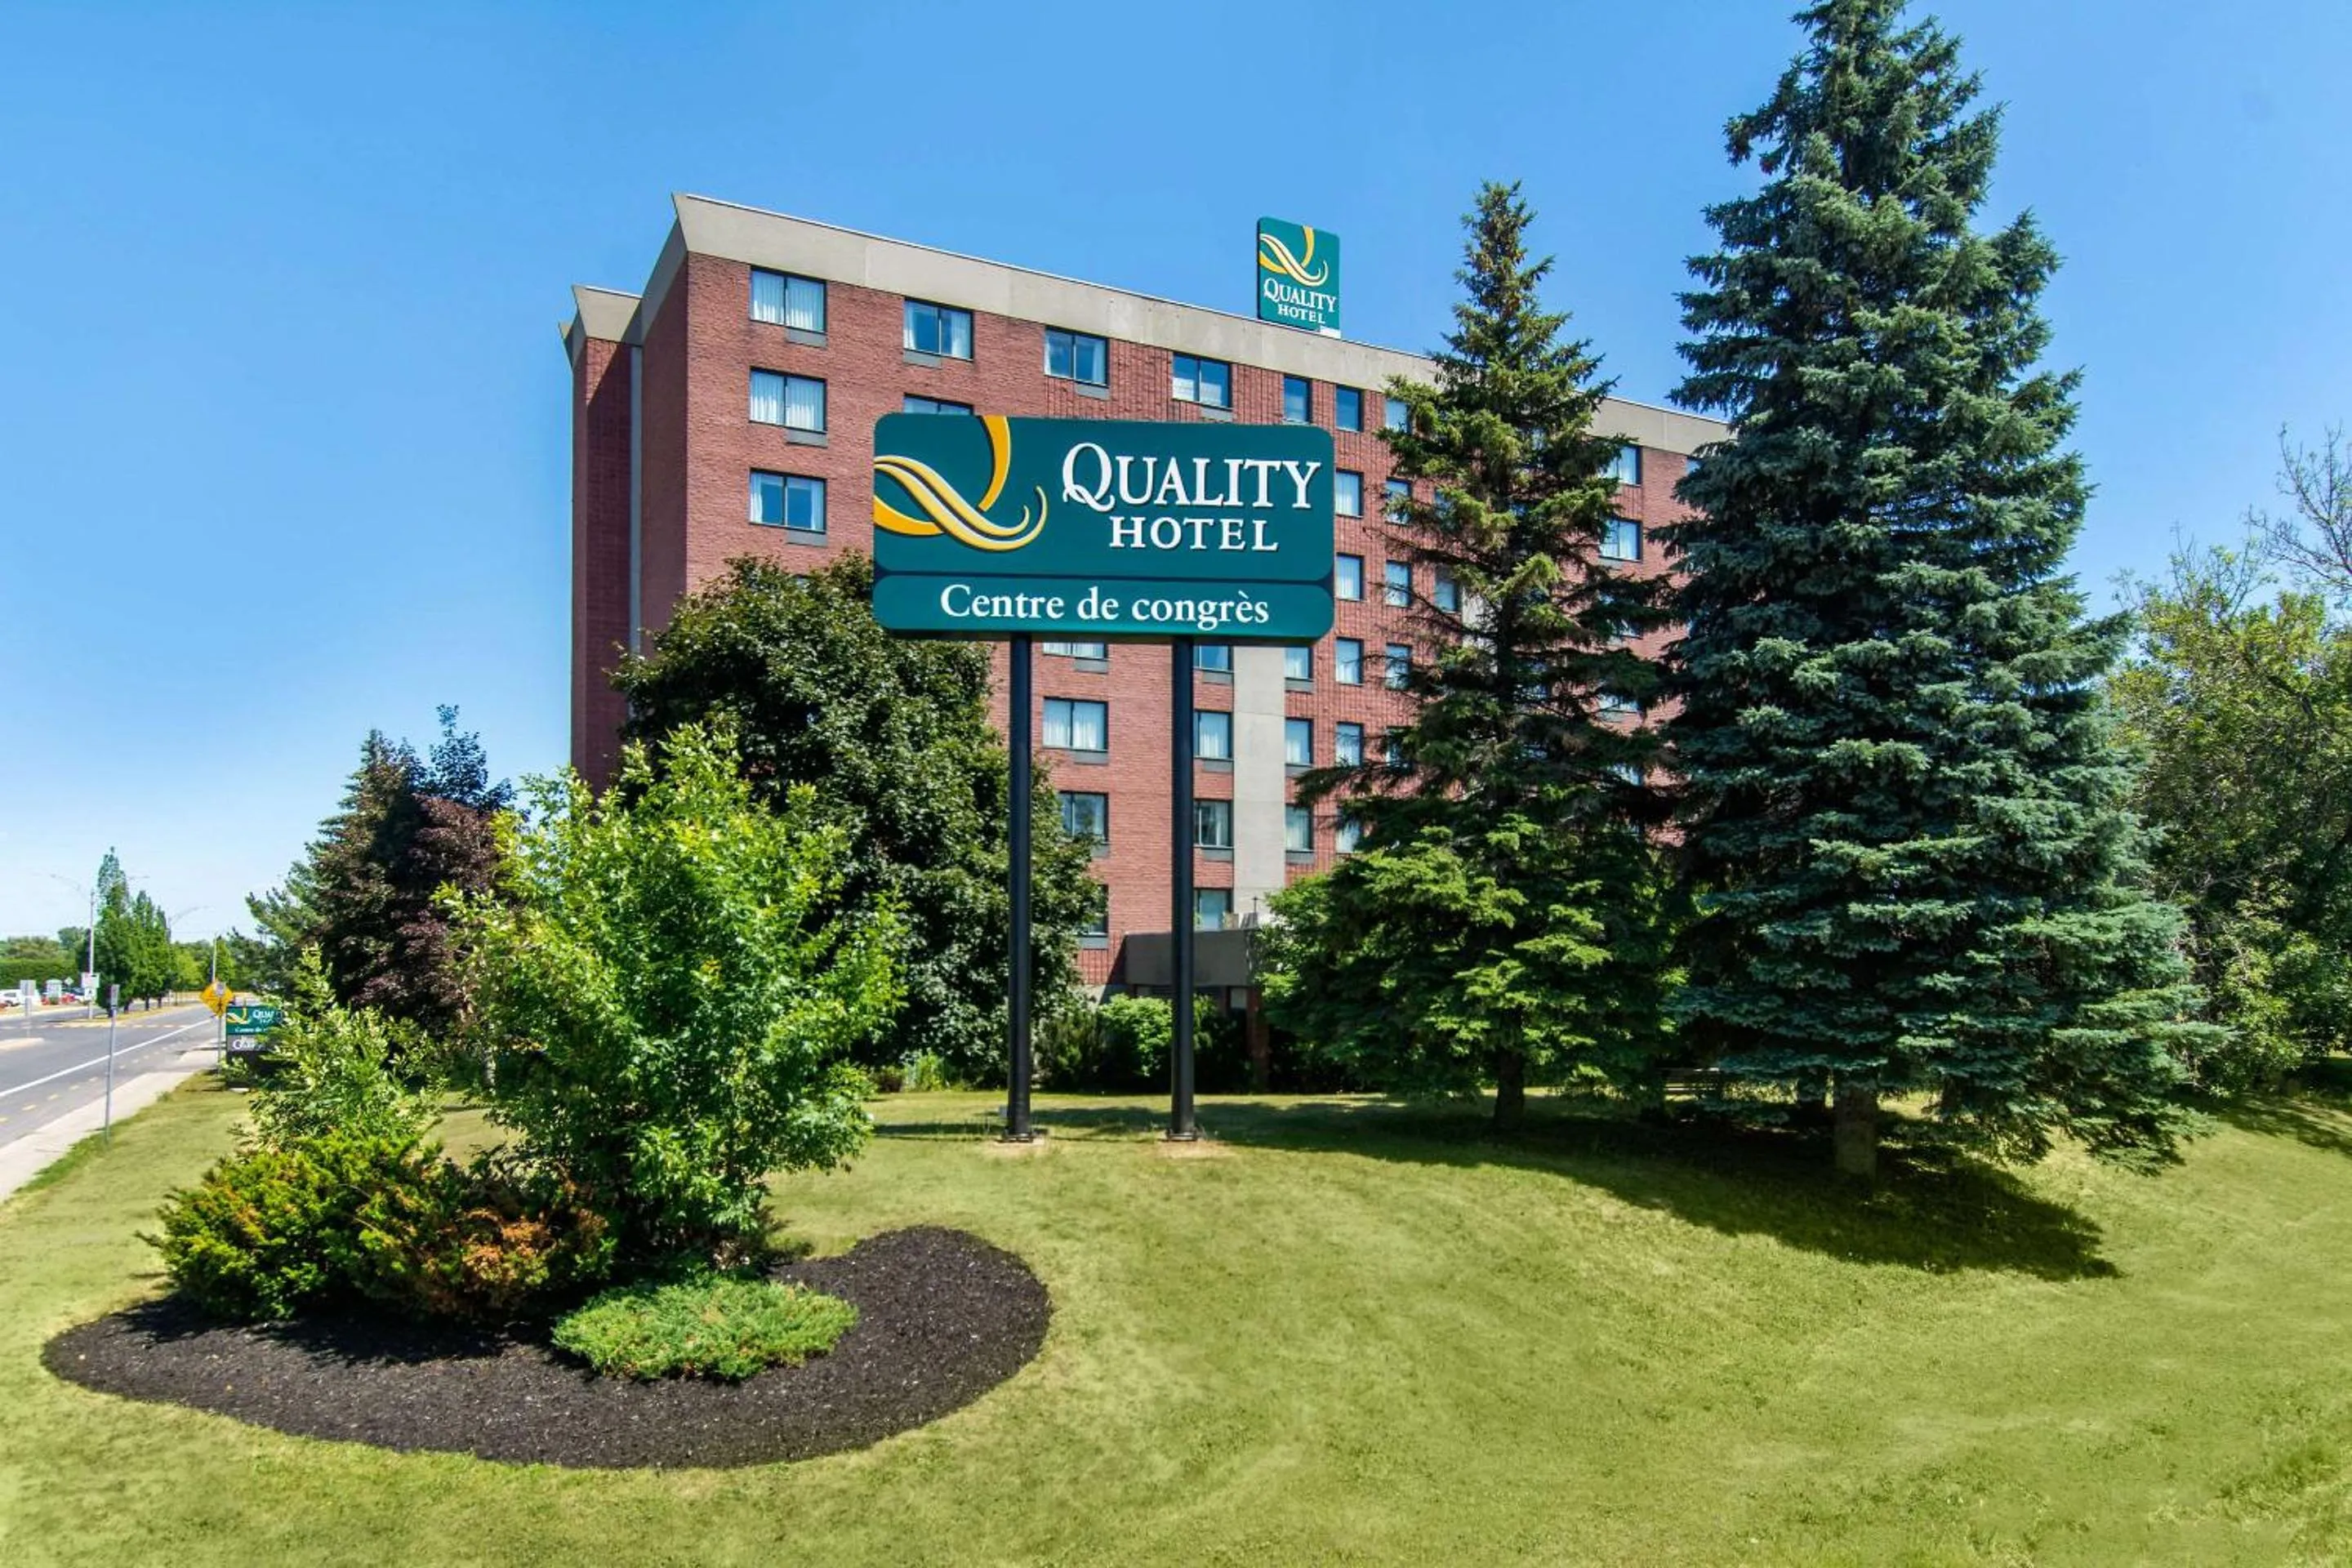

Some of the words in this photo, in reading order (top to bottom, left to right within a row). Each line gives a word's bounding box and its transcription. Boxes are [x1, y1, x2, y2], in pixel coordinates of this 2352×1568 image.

[1264, 278, 1336, 313] QUALITY
[1278, 304, 1325, 323] HOTEL
[1062, 442, 1321, 512] QUALITY
[1109, 516, 1279, 551] HOTEL
[941, 584, 1064, 619] Centre
[1077, 586, 1119, 621] de
[1132, 590, 1270, 630] congrès
